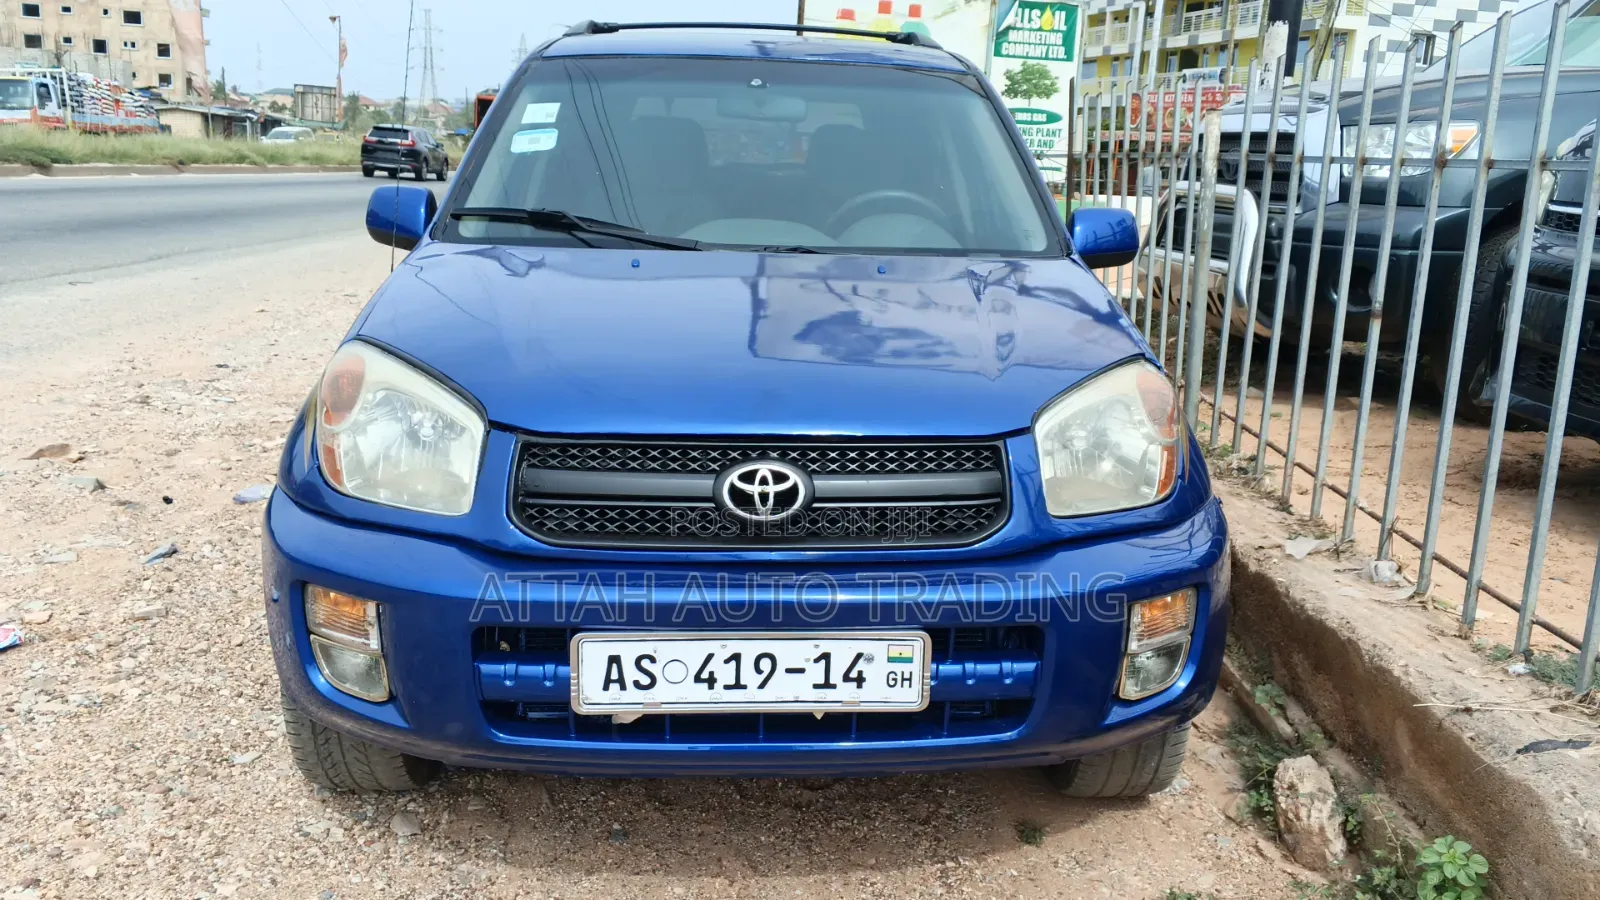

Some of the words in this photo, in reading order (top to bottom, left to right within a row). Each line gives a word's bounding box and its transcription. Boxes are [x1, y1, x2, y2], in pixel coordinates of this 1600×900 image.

[1008, 29, 1063, 45] MARKETING
[1001, 42, 1048, 58] COMPANY
[1048, 45, 1067, 59] LTD.
[1036, 127, 1062, 138] PLANT
[1037, 139, 1054, 149] AND
[602, 653, 658, 692] AS
[693, 651, 867, 691] 419-14
[886, 670, 913, 689] GH
